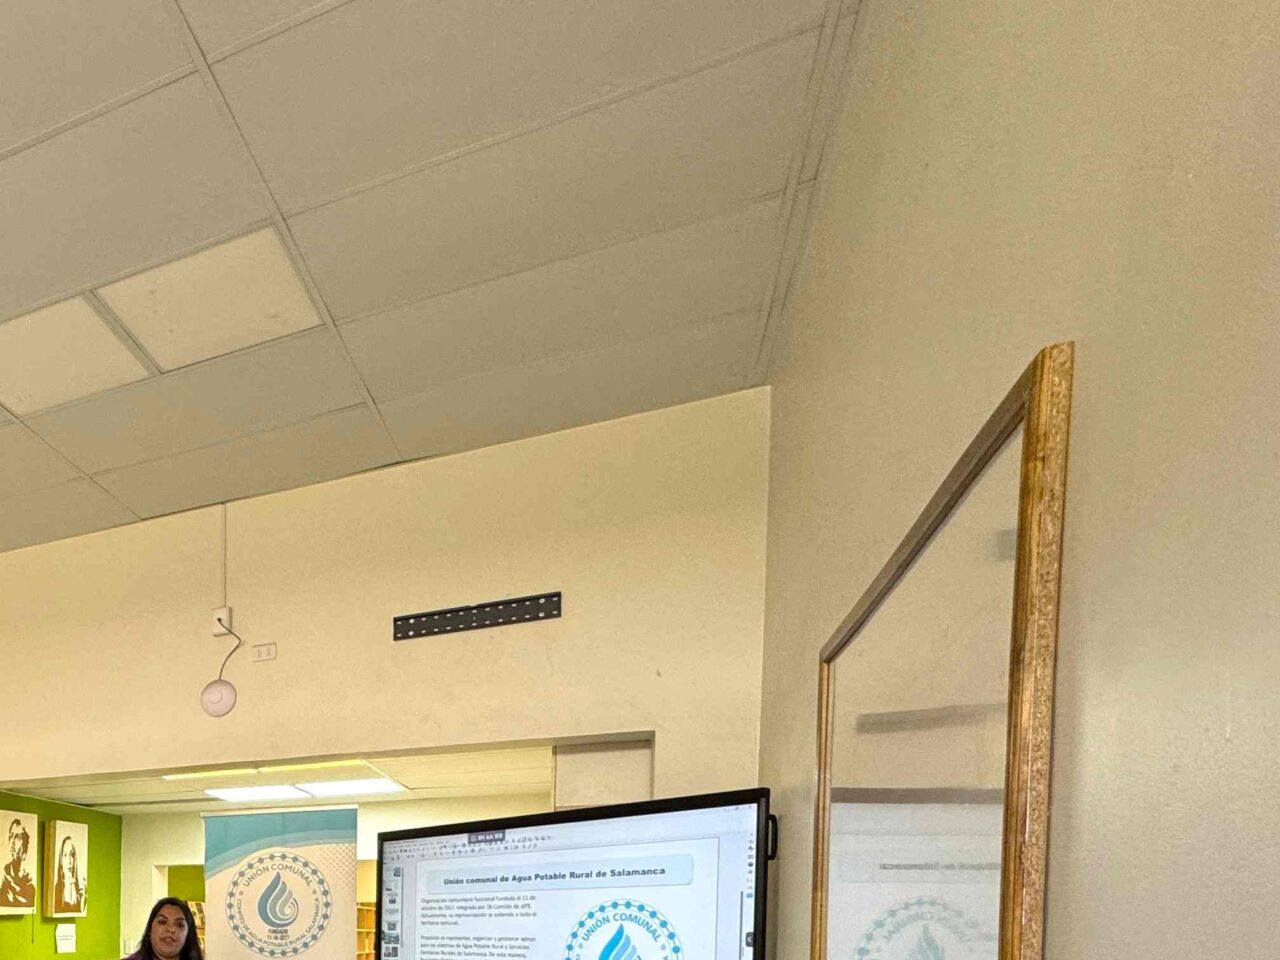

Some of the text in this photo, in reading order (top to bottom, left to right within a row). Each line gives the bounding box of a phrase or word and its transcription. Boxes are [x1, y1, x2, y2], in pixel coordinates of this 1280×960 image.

[243, 863, 313, 887] UNIÓN COMUNAL
[444, 877, 464, 885] Unión
[466, 876, 497, 884] comunal
[512, 874, 532, 883] Agua
[534, 872, 566, 881] Potable
[570, 871, 592, 879] Rural
[596, 870, 607, 878] de
[610, 868, 665, 877] Salamanca
[581, 912, 662, 942] UNIÓN COMUNAL
